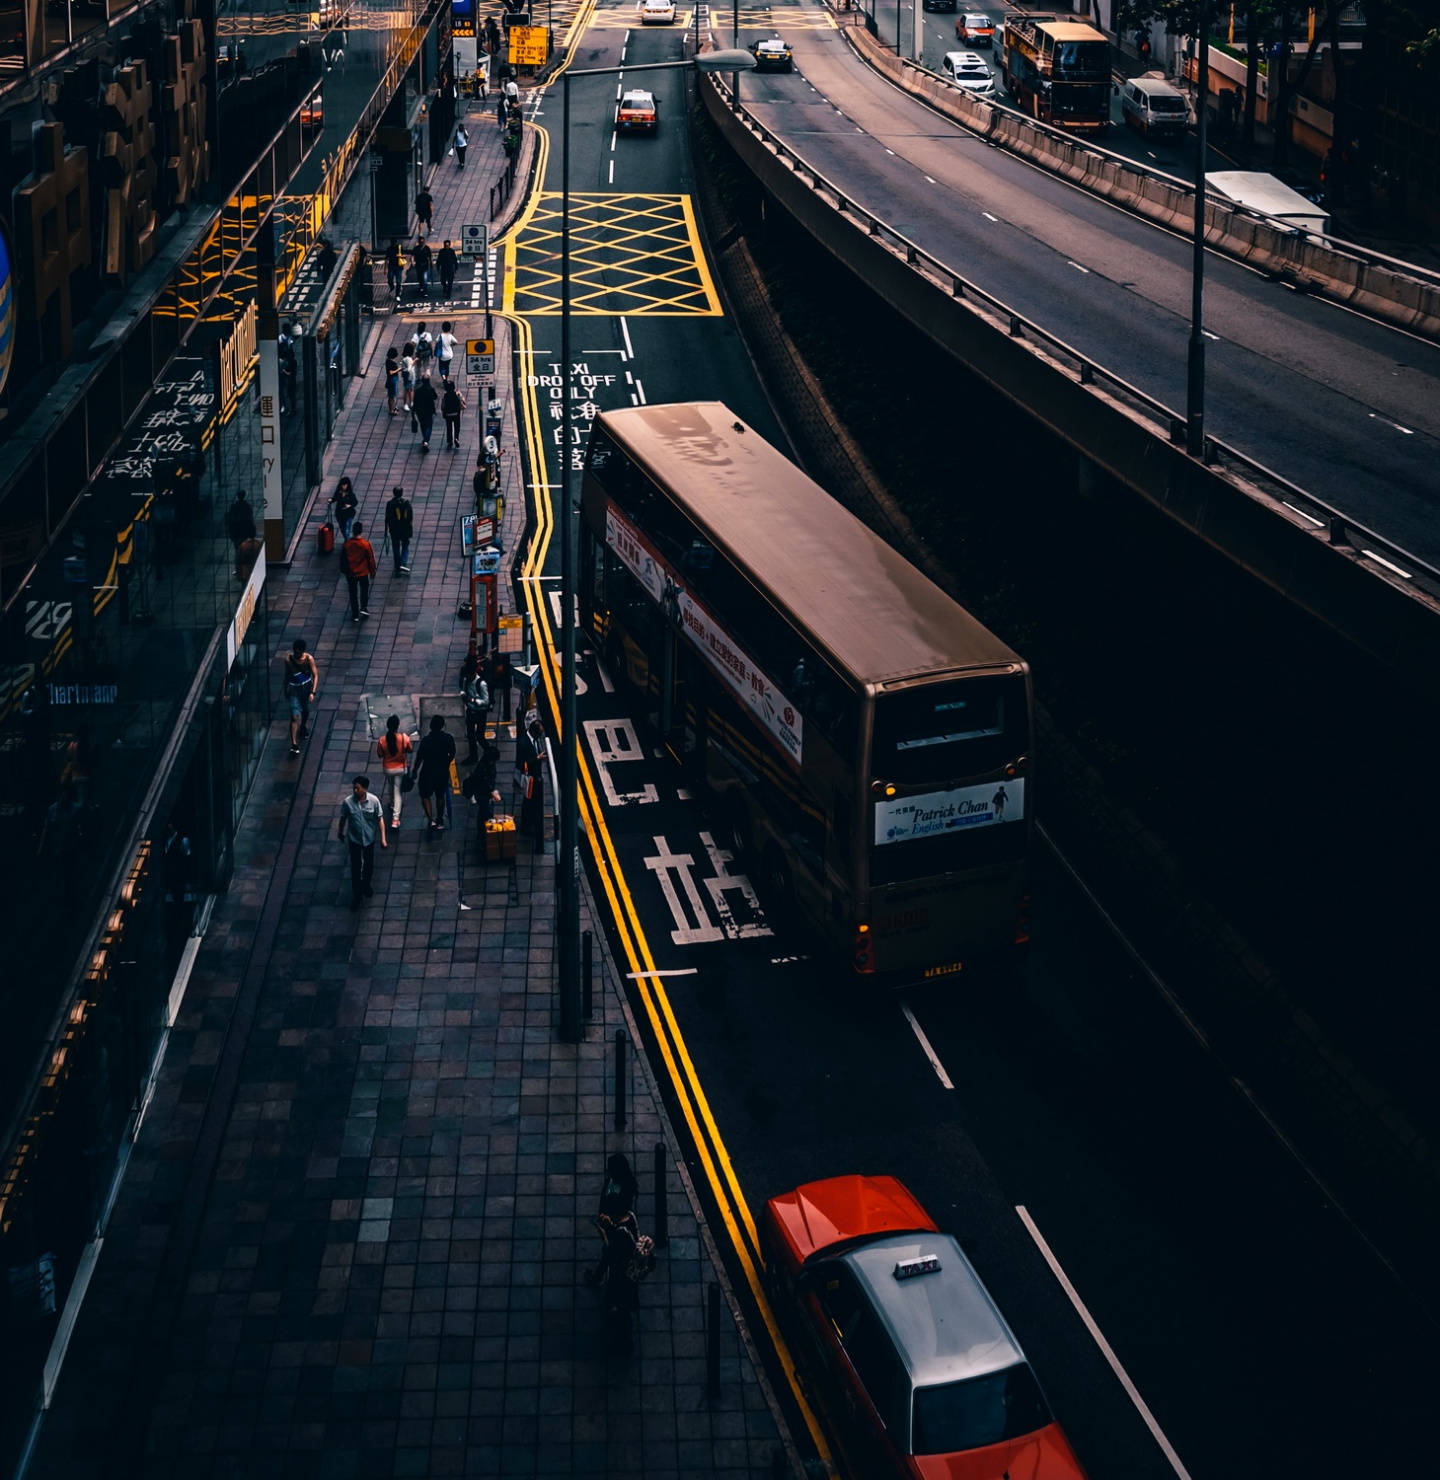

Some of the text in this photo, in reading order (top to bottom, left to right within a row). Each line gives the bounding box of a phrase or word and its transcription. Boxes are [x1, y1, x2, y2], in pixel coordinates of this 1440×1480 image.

[397, 301, 432, 309] LOOK
[472, 363, 490, 371] 全日
[548, 362, 590, 375] TXI
[580, 375, 616, 387] OFF
[912, 803, 955, 823] Patrick
[957, 799, 988, 816] Chan
[911, 819, 945, 836] English
[902, 1258, 938, 1274] TAXI
